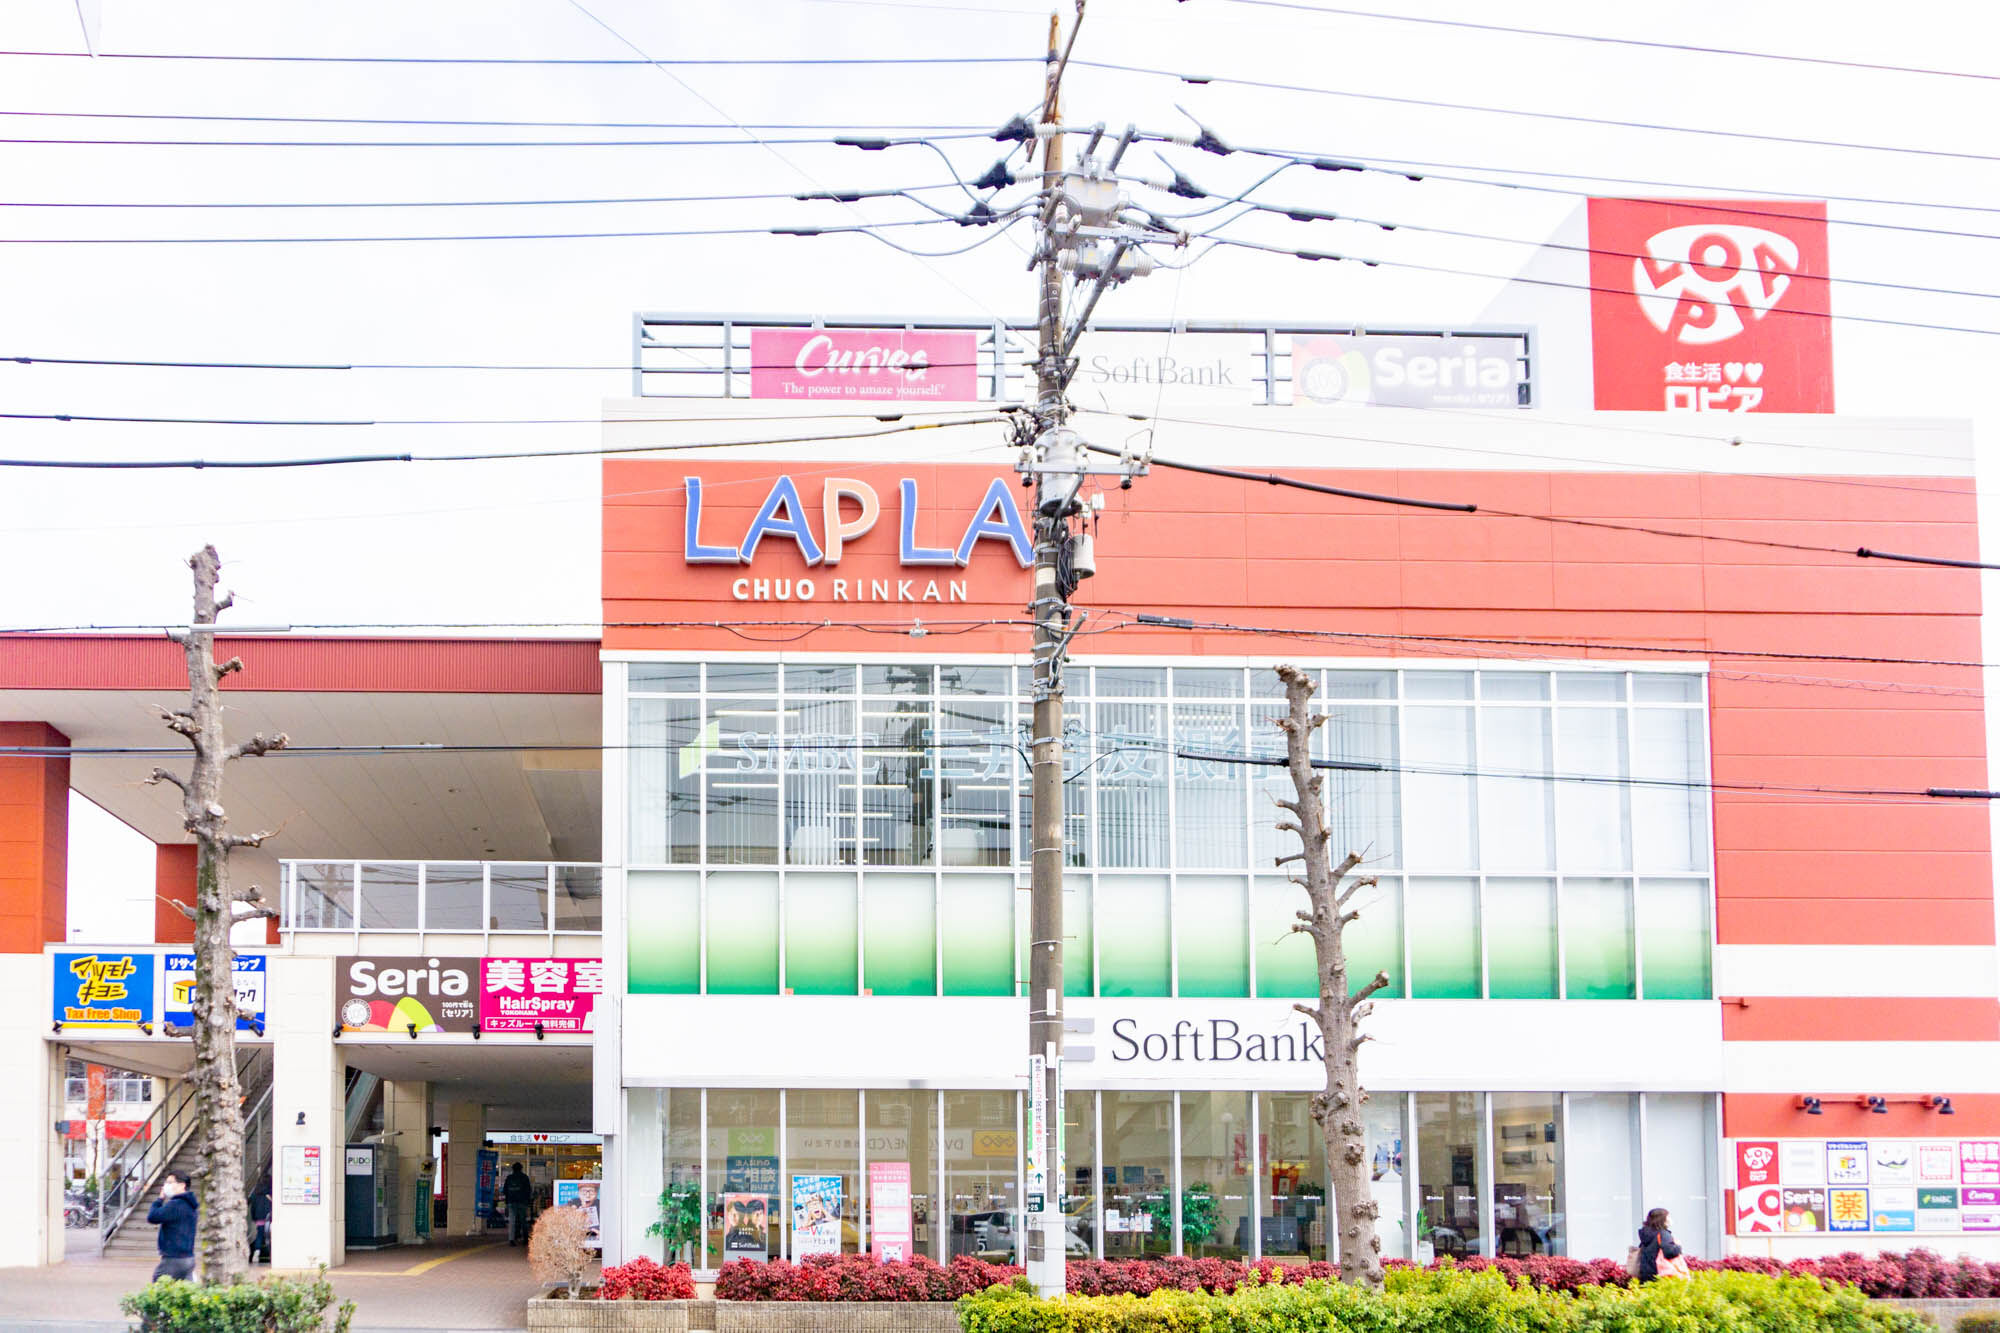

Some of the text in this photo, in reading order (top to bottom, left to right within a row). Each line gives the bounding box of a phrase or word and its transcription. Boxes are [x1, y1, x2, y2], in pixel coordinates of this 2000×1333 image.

[795, 334, 928, 382] Curves
[1091, 355, 1233, 385] SoftBank
[1375, 345, 1511, 387] Seria
[1664, 362, 1721, 382] 食生活
[782, 382, 805, 394] The
[808, 384, 841, 397] power
[845, 384, 857, 394] to
[860, 386, 893, 395] amaze
[684, 475, 1036, 568] LAPLA
[732, 578, 968, 602] CHUO RINKAN
[72, 956, 136, 980] マツモト
[350, 958, 469, 996] Seria
[486, 960, 602, 994] 美容室
[79, 980, 127, 1004] キヨシ
[66, 1007, 141, 1021] Tax Free Shop
[1111, 1018, 1325, 1062] SoftBank
[549, 1134, 570, 1142] ロピア
[348, 1156, 371, 1165] PUDO
[1784, 1190, 1824, 1205] Seria
[1834, 1191, 1863, 1219] 薬
